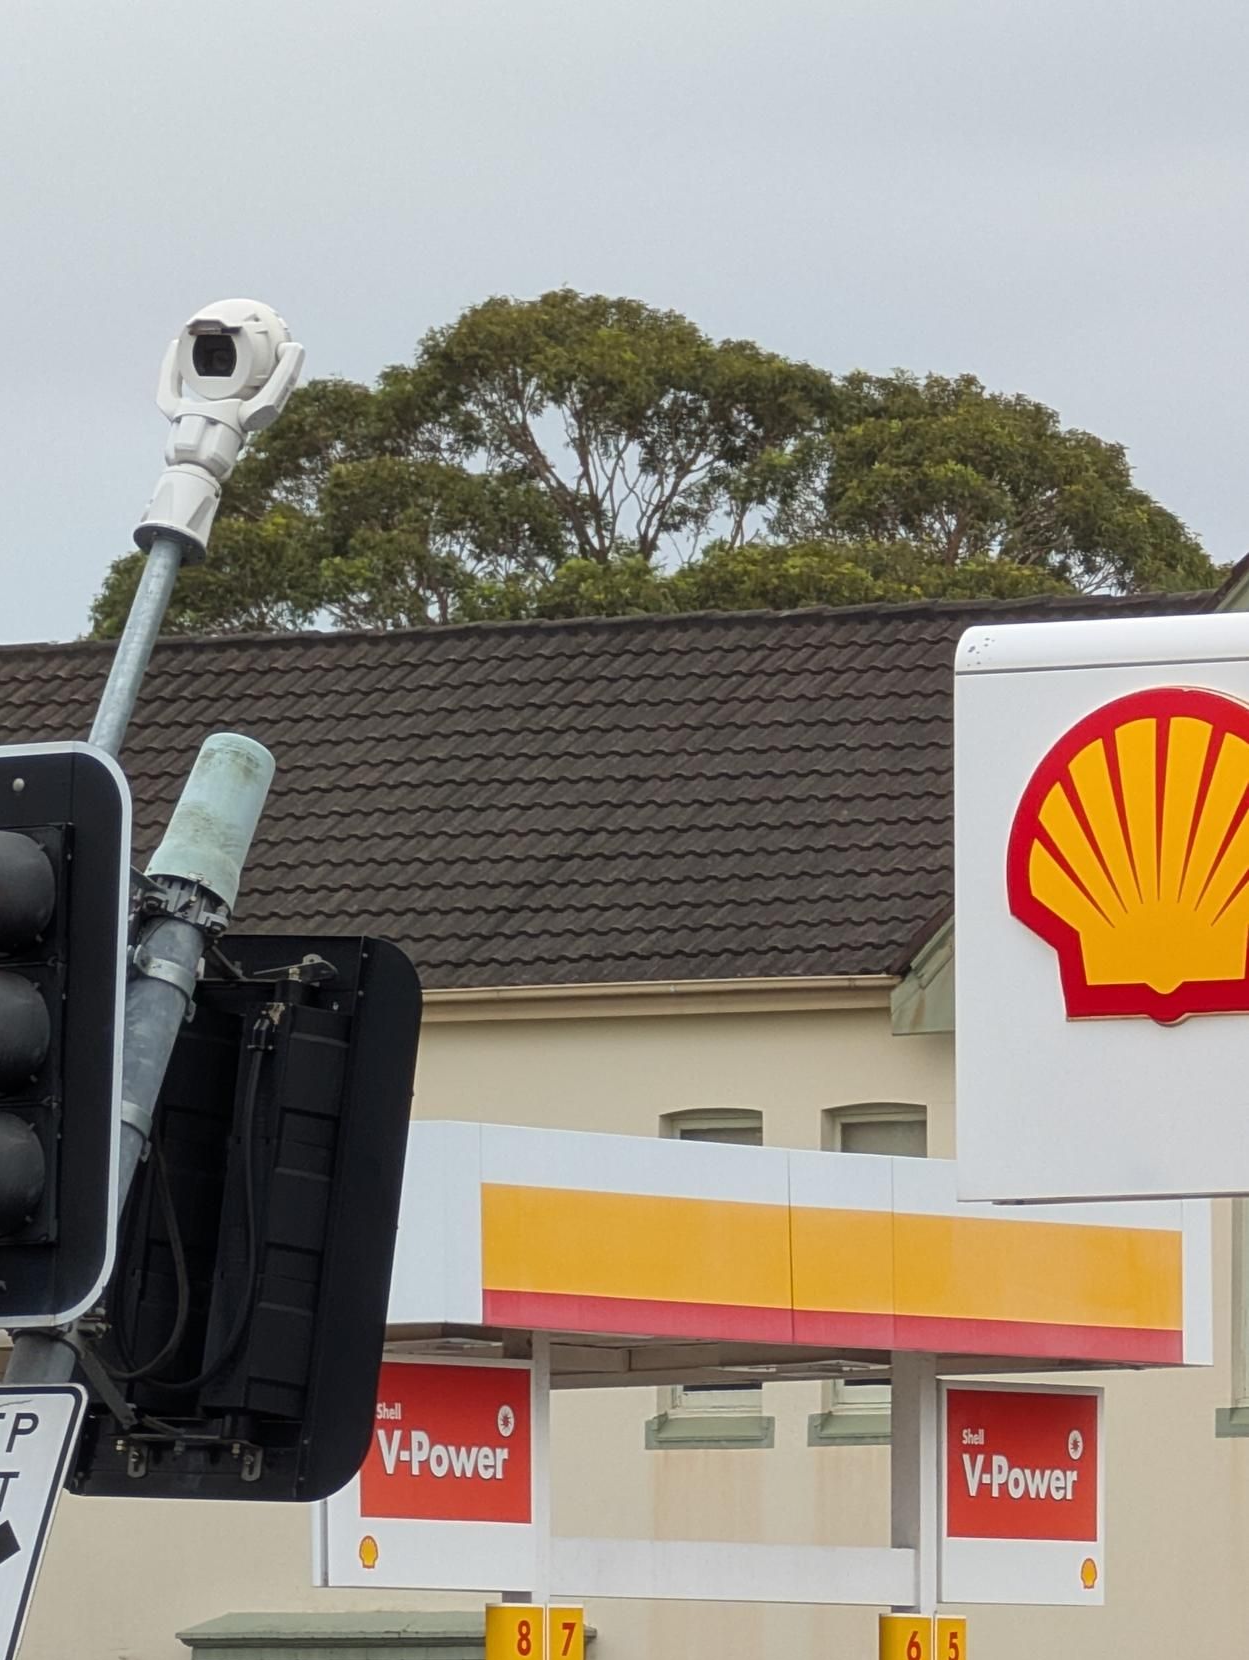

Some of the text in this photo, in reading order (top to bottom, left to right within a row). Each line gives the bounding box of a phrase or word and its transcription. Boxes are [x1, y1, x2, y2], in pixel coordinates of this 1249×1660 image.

[376, 1402, 401, 1420] Shell
[962, 1428, 985, 1445] Shell
[377, 1429, 510, 1480] V-Power
[962, 1453, 1078, 1501] V-Power
[517, 1620, 532, 1656] 8
[561, 1621, 576, 1656] 7
